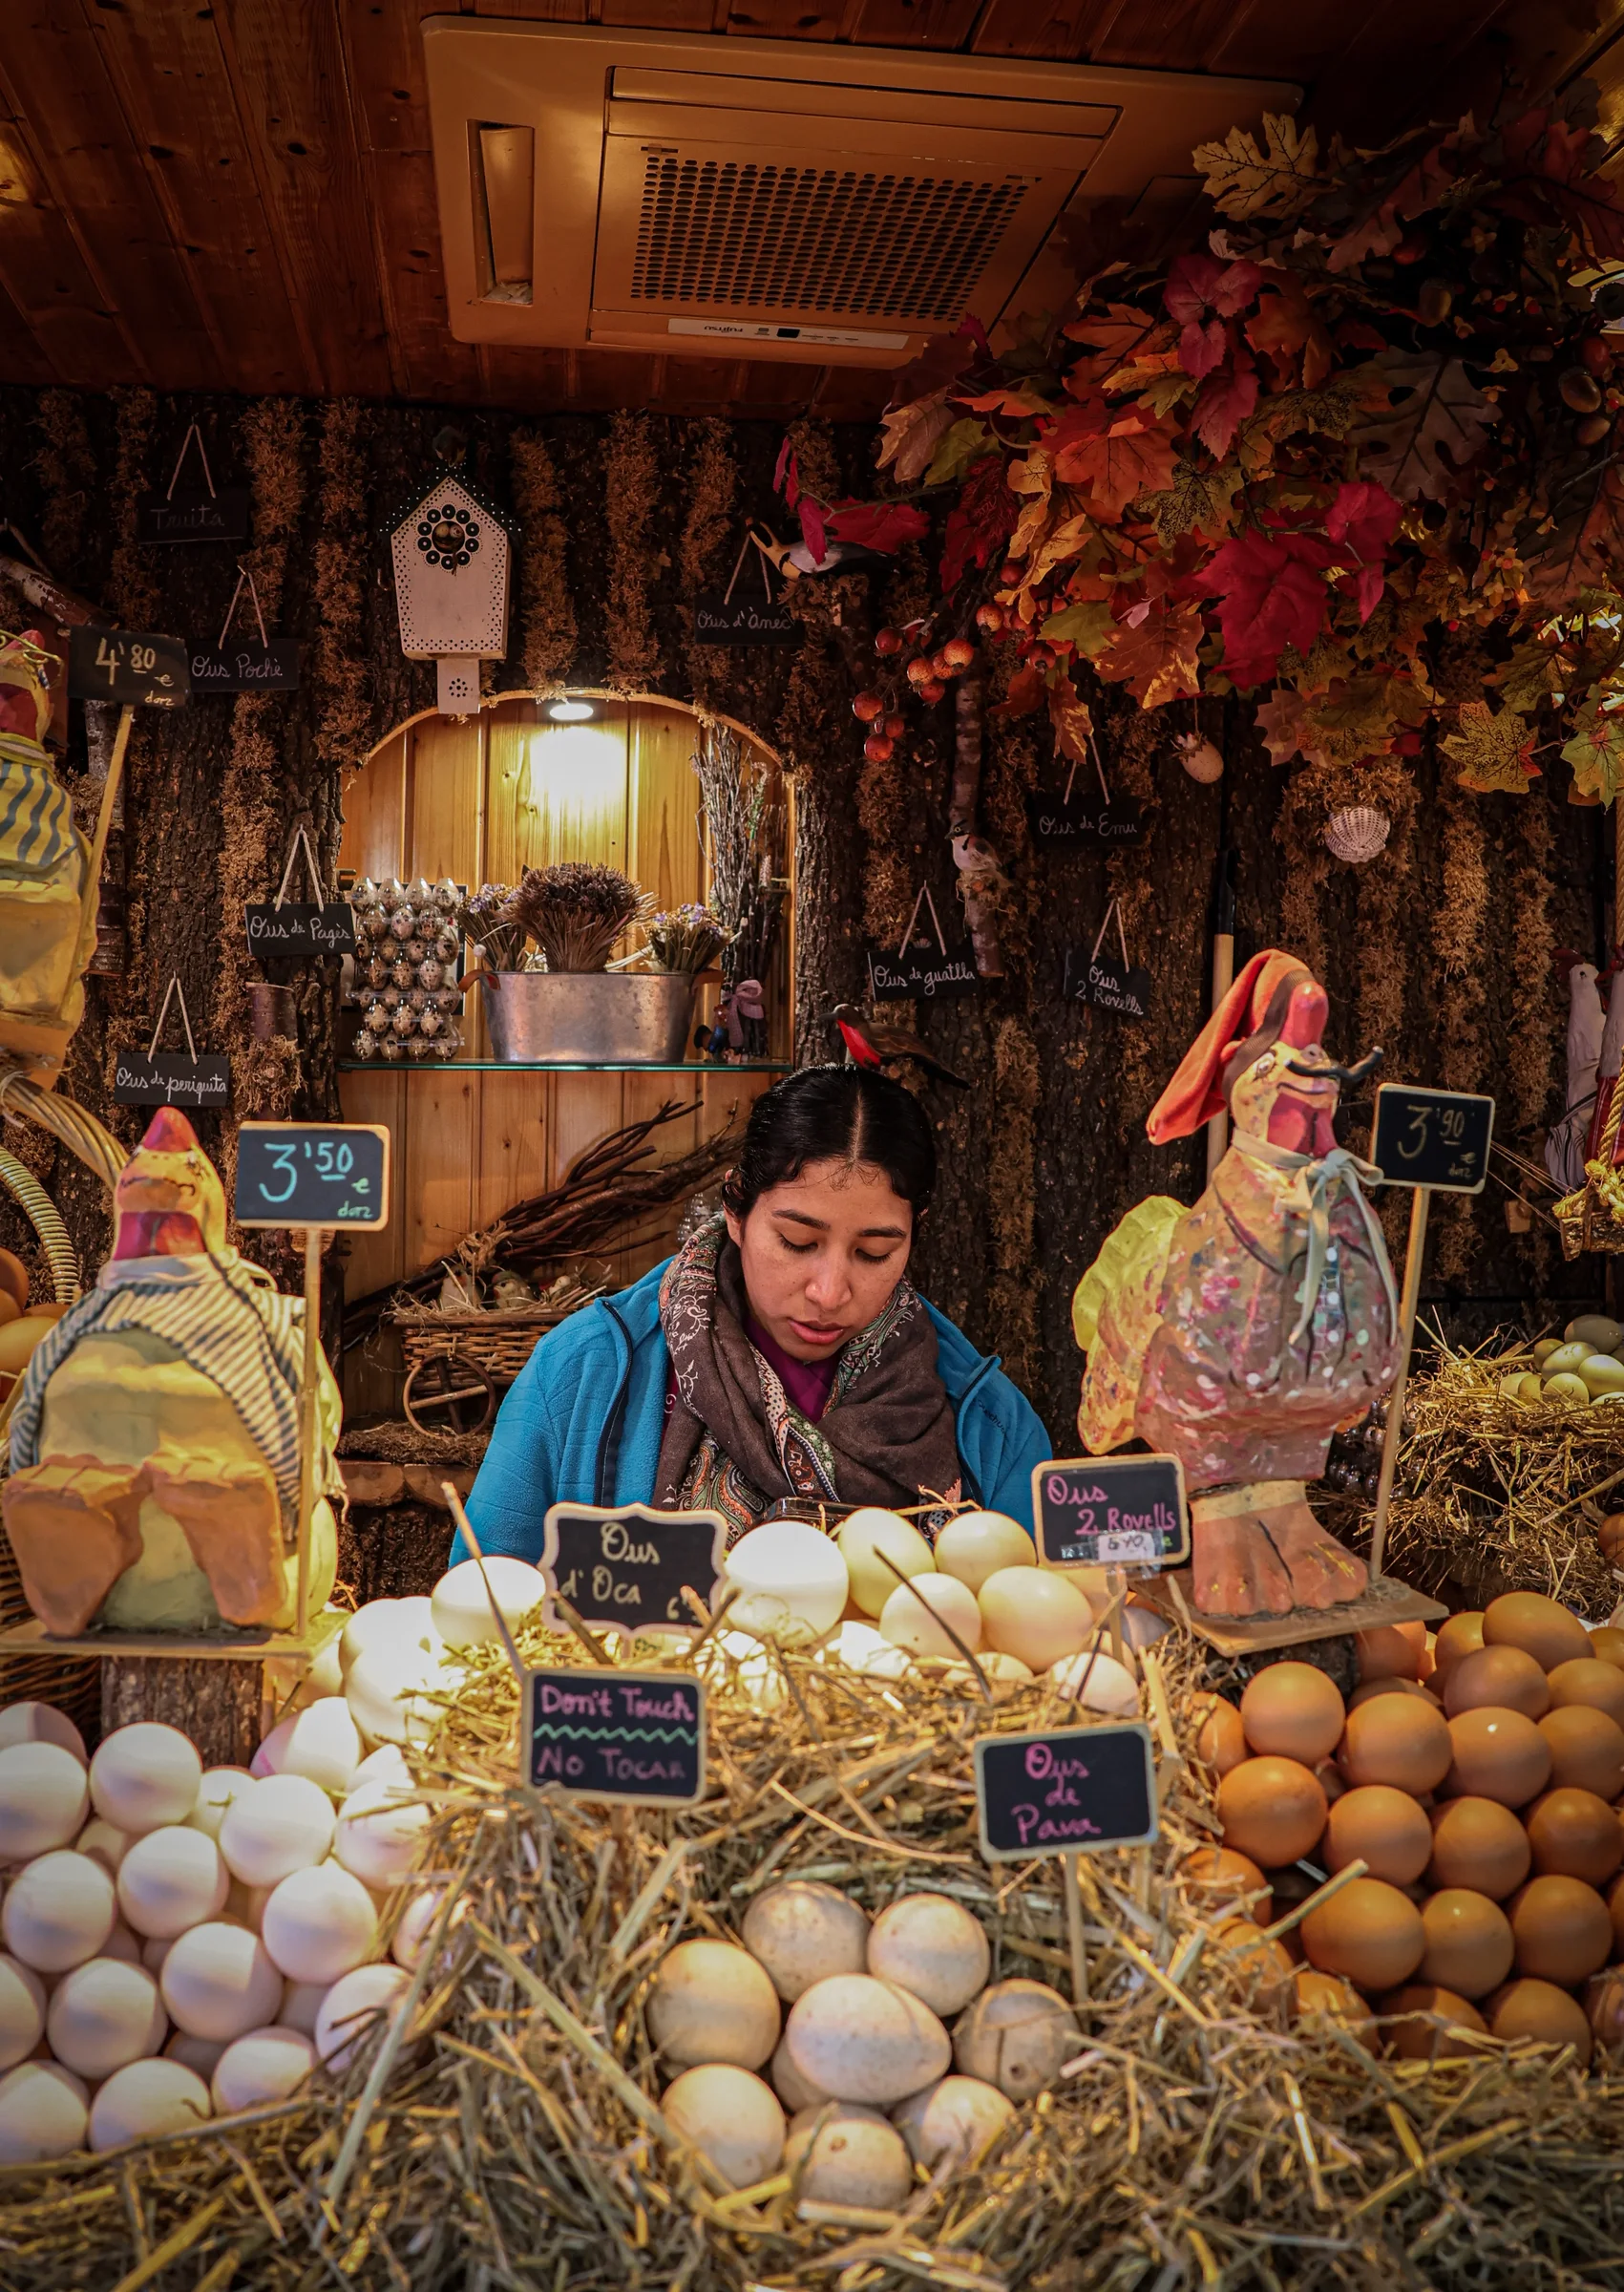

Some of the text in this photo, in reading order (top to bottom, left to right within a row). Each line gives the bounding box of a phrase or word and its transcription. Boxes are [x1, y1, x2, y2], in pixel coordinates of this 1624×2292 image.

[704, 325, 744, 334] FUJITSU
[149, 504, 225, 530] Truita
[696, 610, 729, 629] Ous
[191, 655, 231, 678] Ous
[1038, 812, 1138, 837] Ous de Emu
[249, 915, 351, 949] Ous de Pagès
[873, 965, 909, 987] Ous
[909, 966, 923, 980] de
[1088, 965, 1121, 993] Ous
[1074, 980, 1145, 1016] 2 Rovells
[116, 1067, 149, 1090] Ous
[150, 1071, 165, 1086] de
[1396, 1103, 1466, 1161] 3'90
[258, 1141, 353, 1203] 3'50
[1046, 1475, 1108, 1506] Ous
[1075, 1501, 1176, 1537] 2 Rovells
[600, 1520, 661, 1565] Ous
[540, 1684, 695, 1722] Don't Touch
[1024, 1742, 1090, 1780] Ous
[1044, 1772, 1082, 1807] de
[1011, 1802, 1102, 1845] Pava
